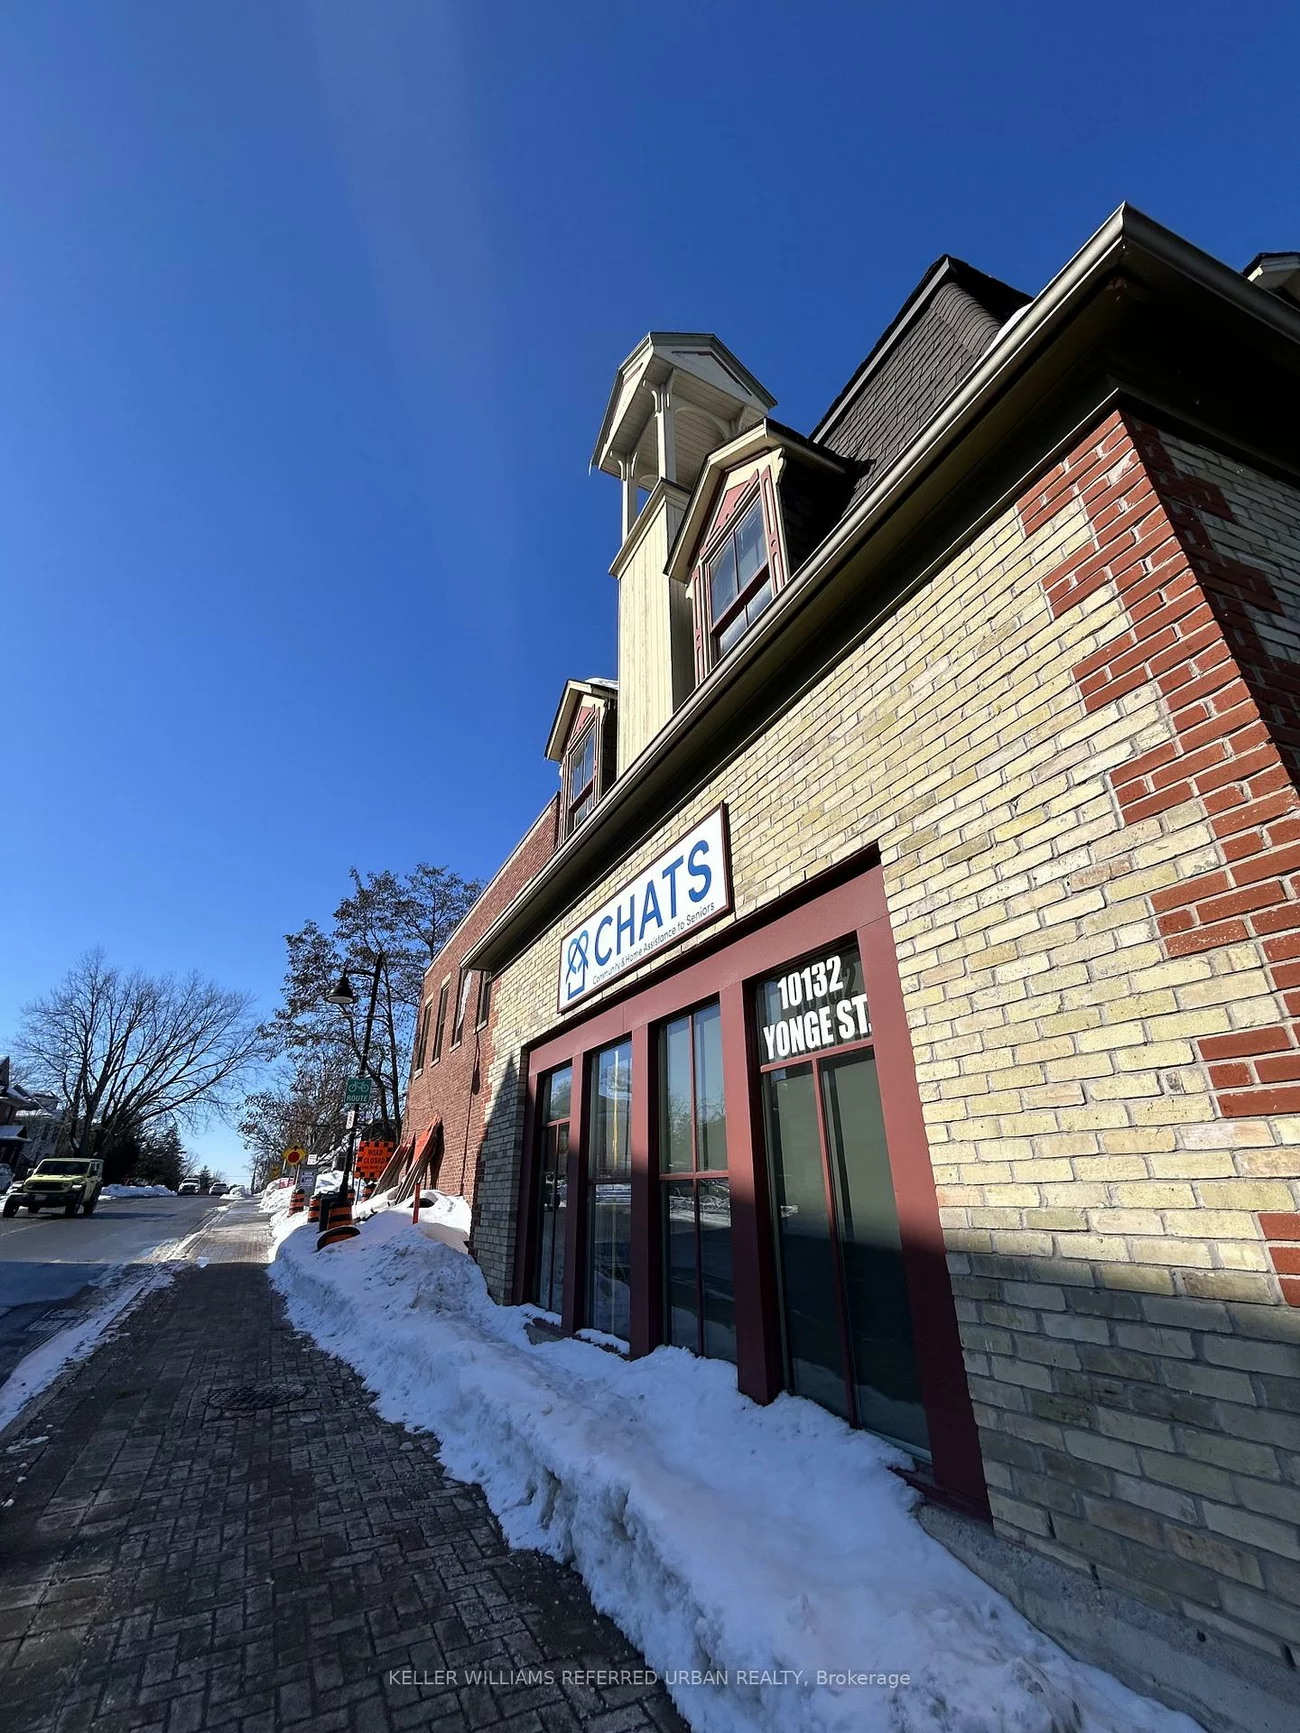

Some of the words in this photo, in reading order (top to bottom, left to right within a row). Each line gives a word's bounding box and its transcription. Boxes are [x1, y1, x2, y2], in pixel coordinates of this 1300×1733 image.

[594, 839, 712, 967] CHATS
[592, 962, 620, 985] Community
[625, 948, 643, 964] Home
[643, 926, 677, 953] Assistance
[677, 920, 686, 932] to
[686, 902, 715, 926] Seniors
[777, 955, 844, 1010] 10132
[762, 1005, 835, 1060] YONGE
[836, 993, 872, 1040] ST.
[346, 1094, 369, 1102] ROUTE
